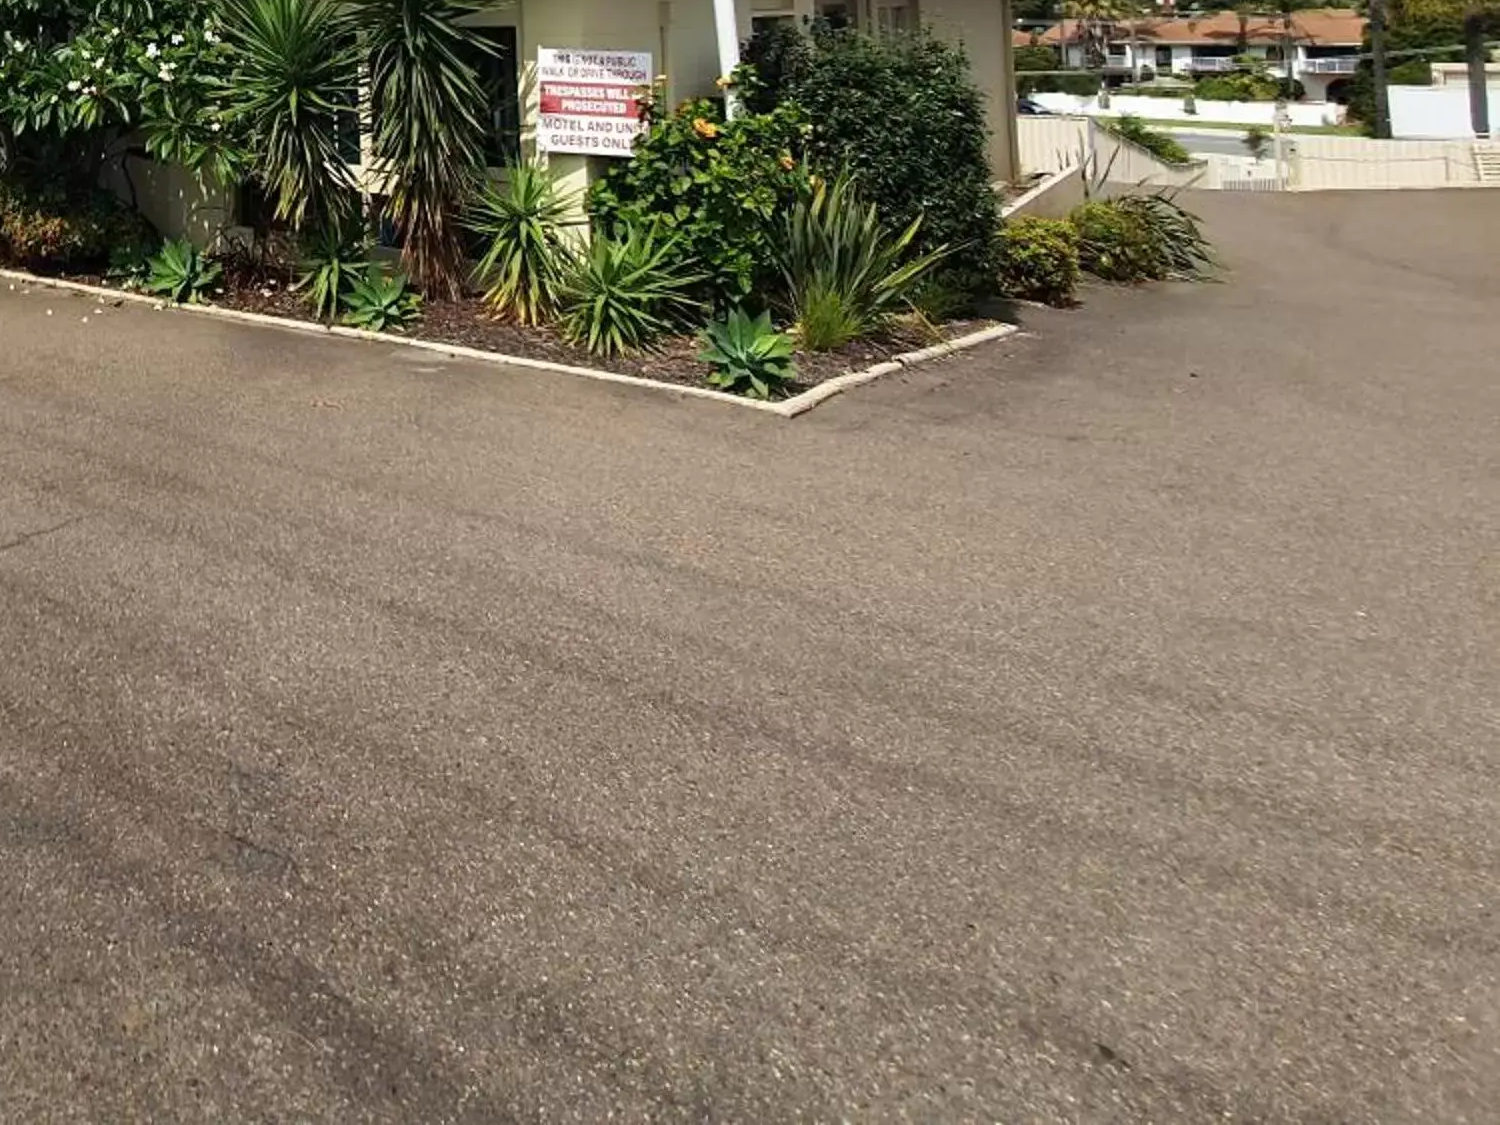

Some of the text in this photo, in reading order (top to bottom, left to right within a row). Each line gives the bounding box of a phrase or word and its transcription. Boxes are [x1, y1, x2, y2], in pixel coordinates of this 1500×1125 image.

[544, 118, 584, 132] MOTEL
[587, 121, 613, 133] AND
[551, 134, 599, 148] GUESTS
